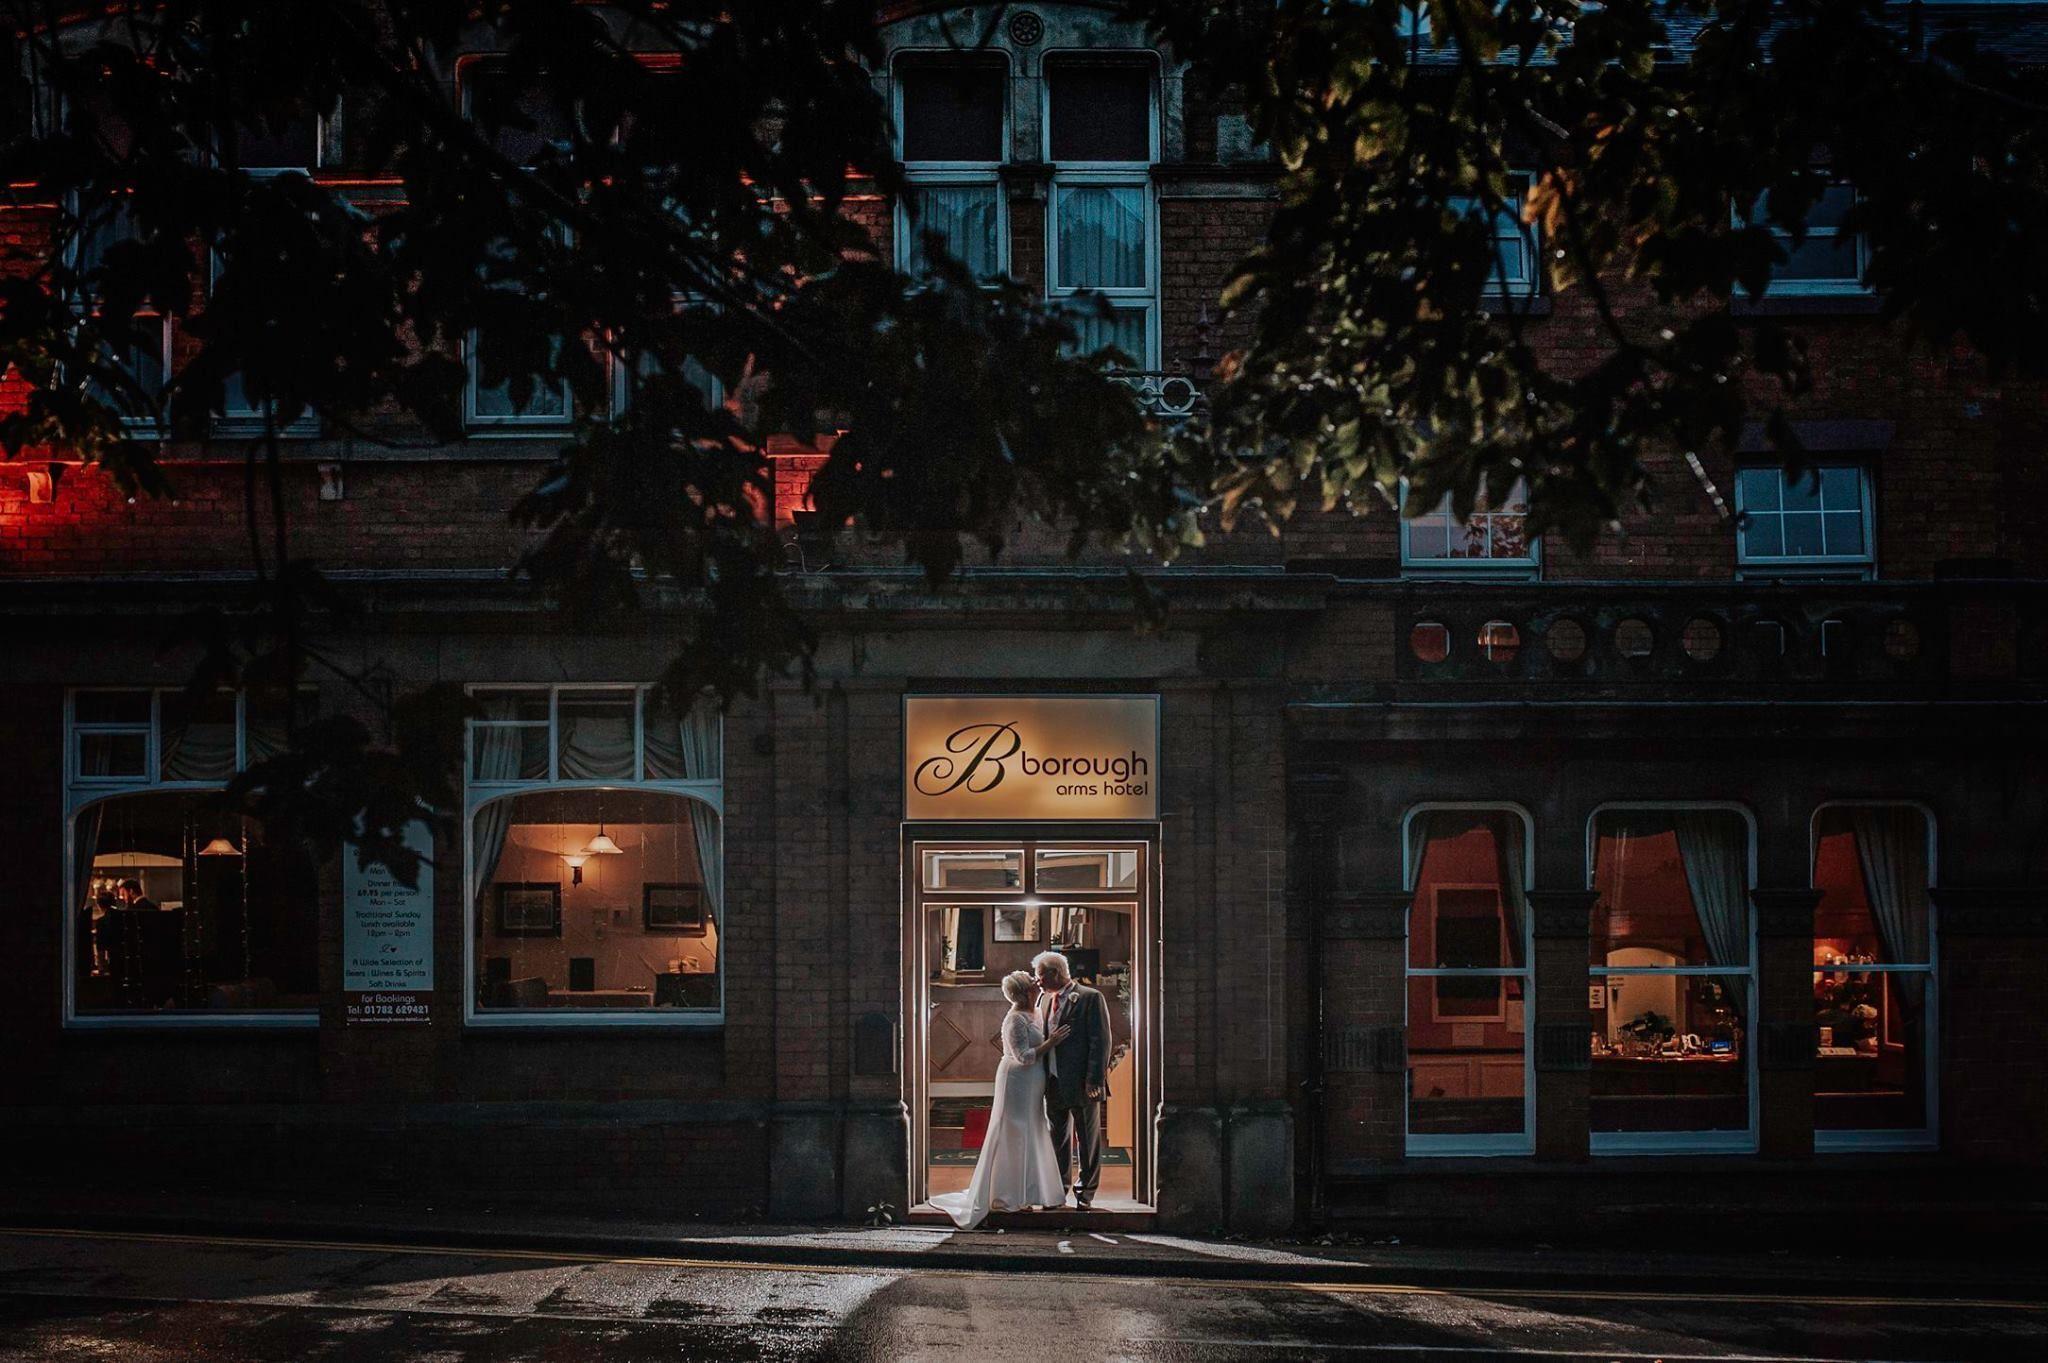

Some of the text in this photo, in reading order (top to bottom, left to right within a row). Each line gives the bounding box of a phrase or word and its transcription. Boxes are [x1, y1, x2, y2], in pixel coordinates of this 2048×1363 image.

[914, 721, 1021, 796] B
[1021, 751, 1148, 783] borough
[1056, 781, 1148, 796] arms hotel
[355, 911, 421, 919] Traditional Sunday
[382, 920, 415, 928] available
[381, 958, 414, 966] Selection
[415, 958, 424, 966] of
[403, 969, 426, 978] Spirits
[375, 994, 416, 1005] Bookings
[347, 1005, 429, 1014] Tel: 01782 629421
